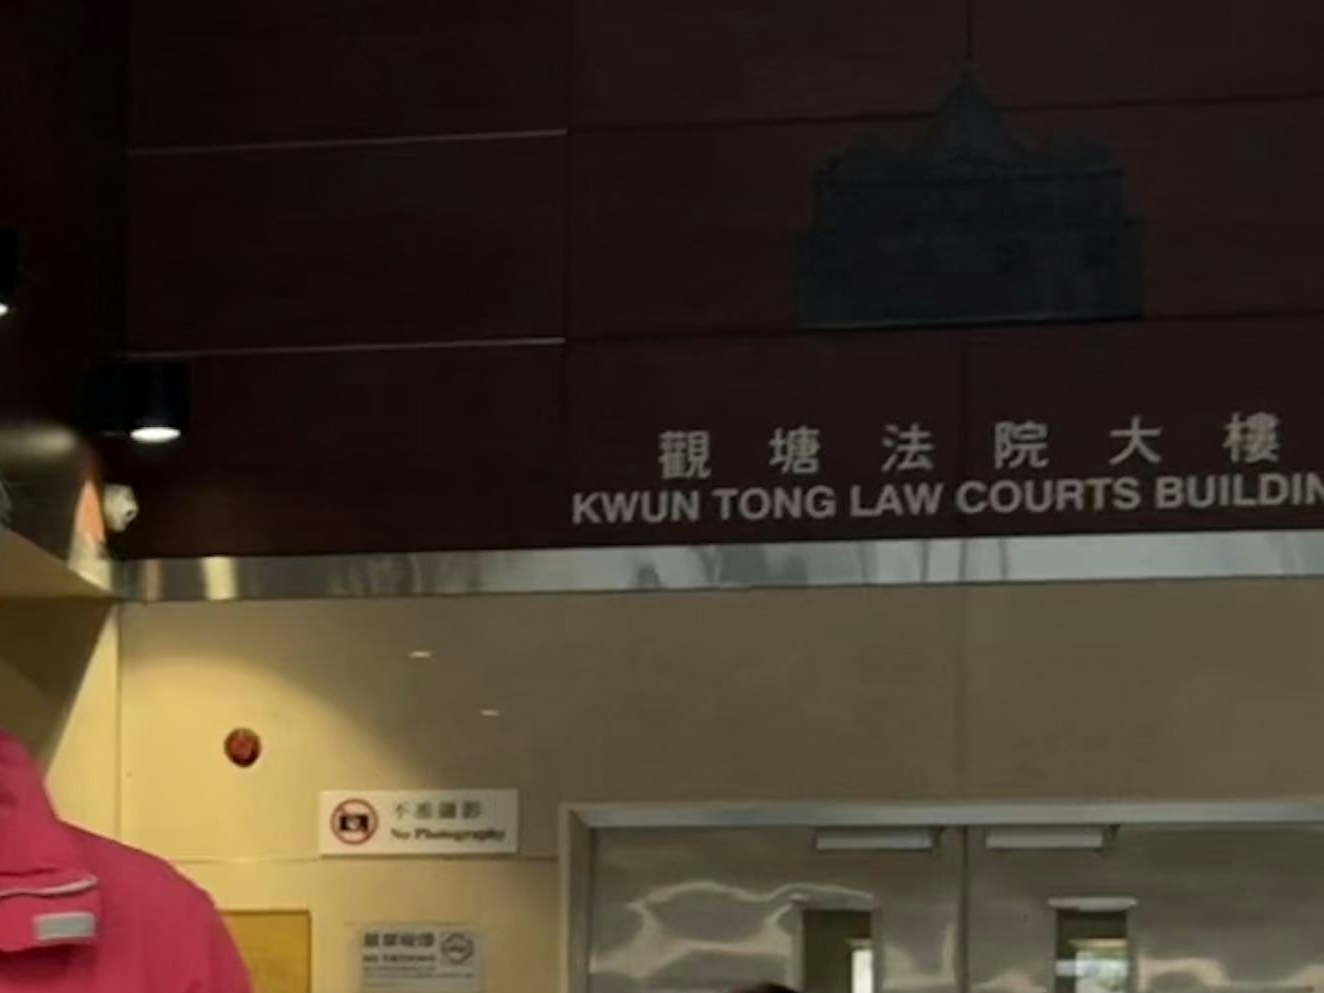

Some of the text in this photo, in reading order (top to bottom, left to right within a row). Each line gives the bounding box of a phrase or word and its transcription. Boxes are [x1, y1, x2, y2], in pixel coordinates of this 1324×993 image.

[658, 411, 1280, 480] 觀塘法院大樓
[572, 489, 700, 524] KWUN
[712, 485, 836, 520] TONG
[850, 482, 944, 517] LAW
[955, 477, 1140, 514] COURTS
